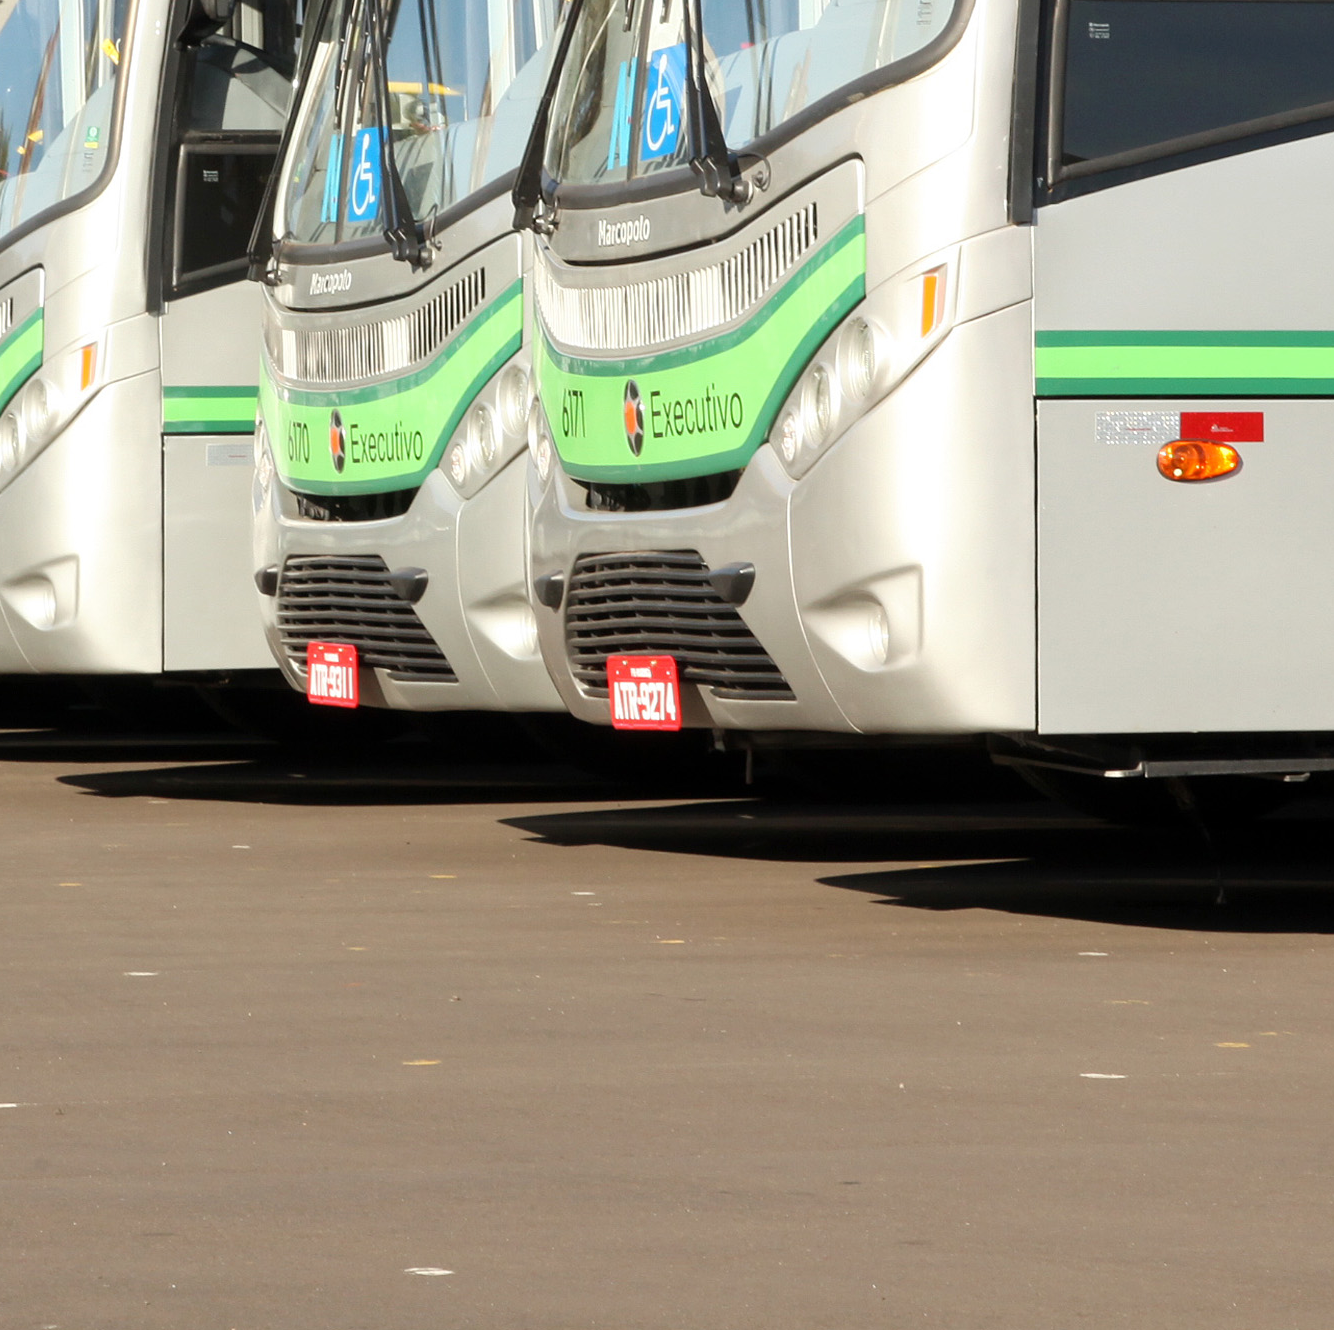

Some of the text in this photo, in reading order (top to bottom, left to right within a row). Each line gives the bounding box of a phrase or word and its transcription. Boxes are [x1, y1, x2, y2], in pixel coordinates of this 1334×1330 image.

[598, 214, 651, 247] Marcopolo
[309, 268, 352, 296] Marcopolo
[561, 382, 744, 439] 6171 Executivo
[350, 420, 424, 464] Executivo
[613, 681, 677, 721] ATR-9274
